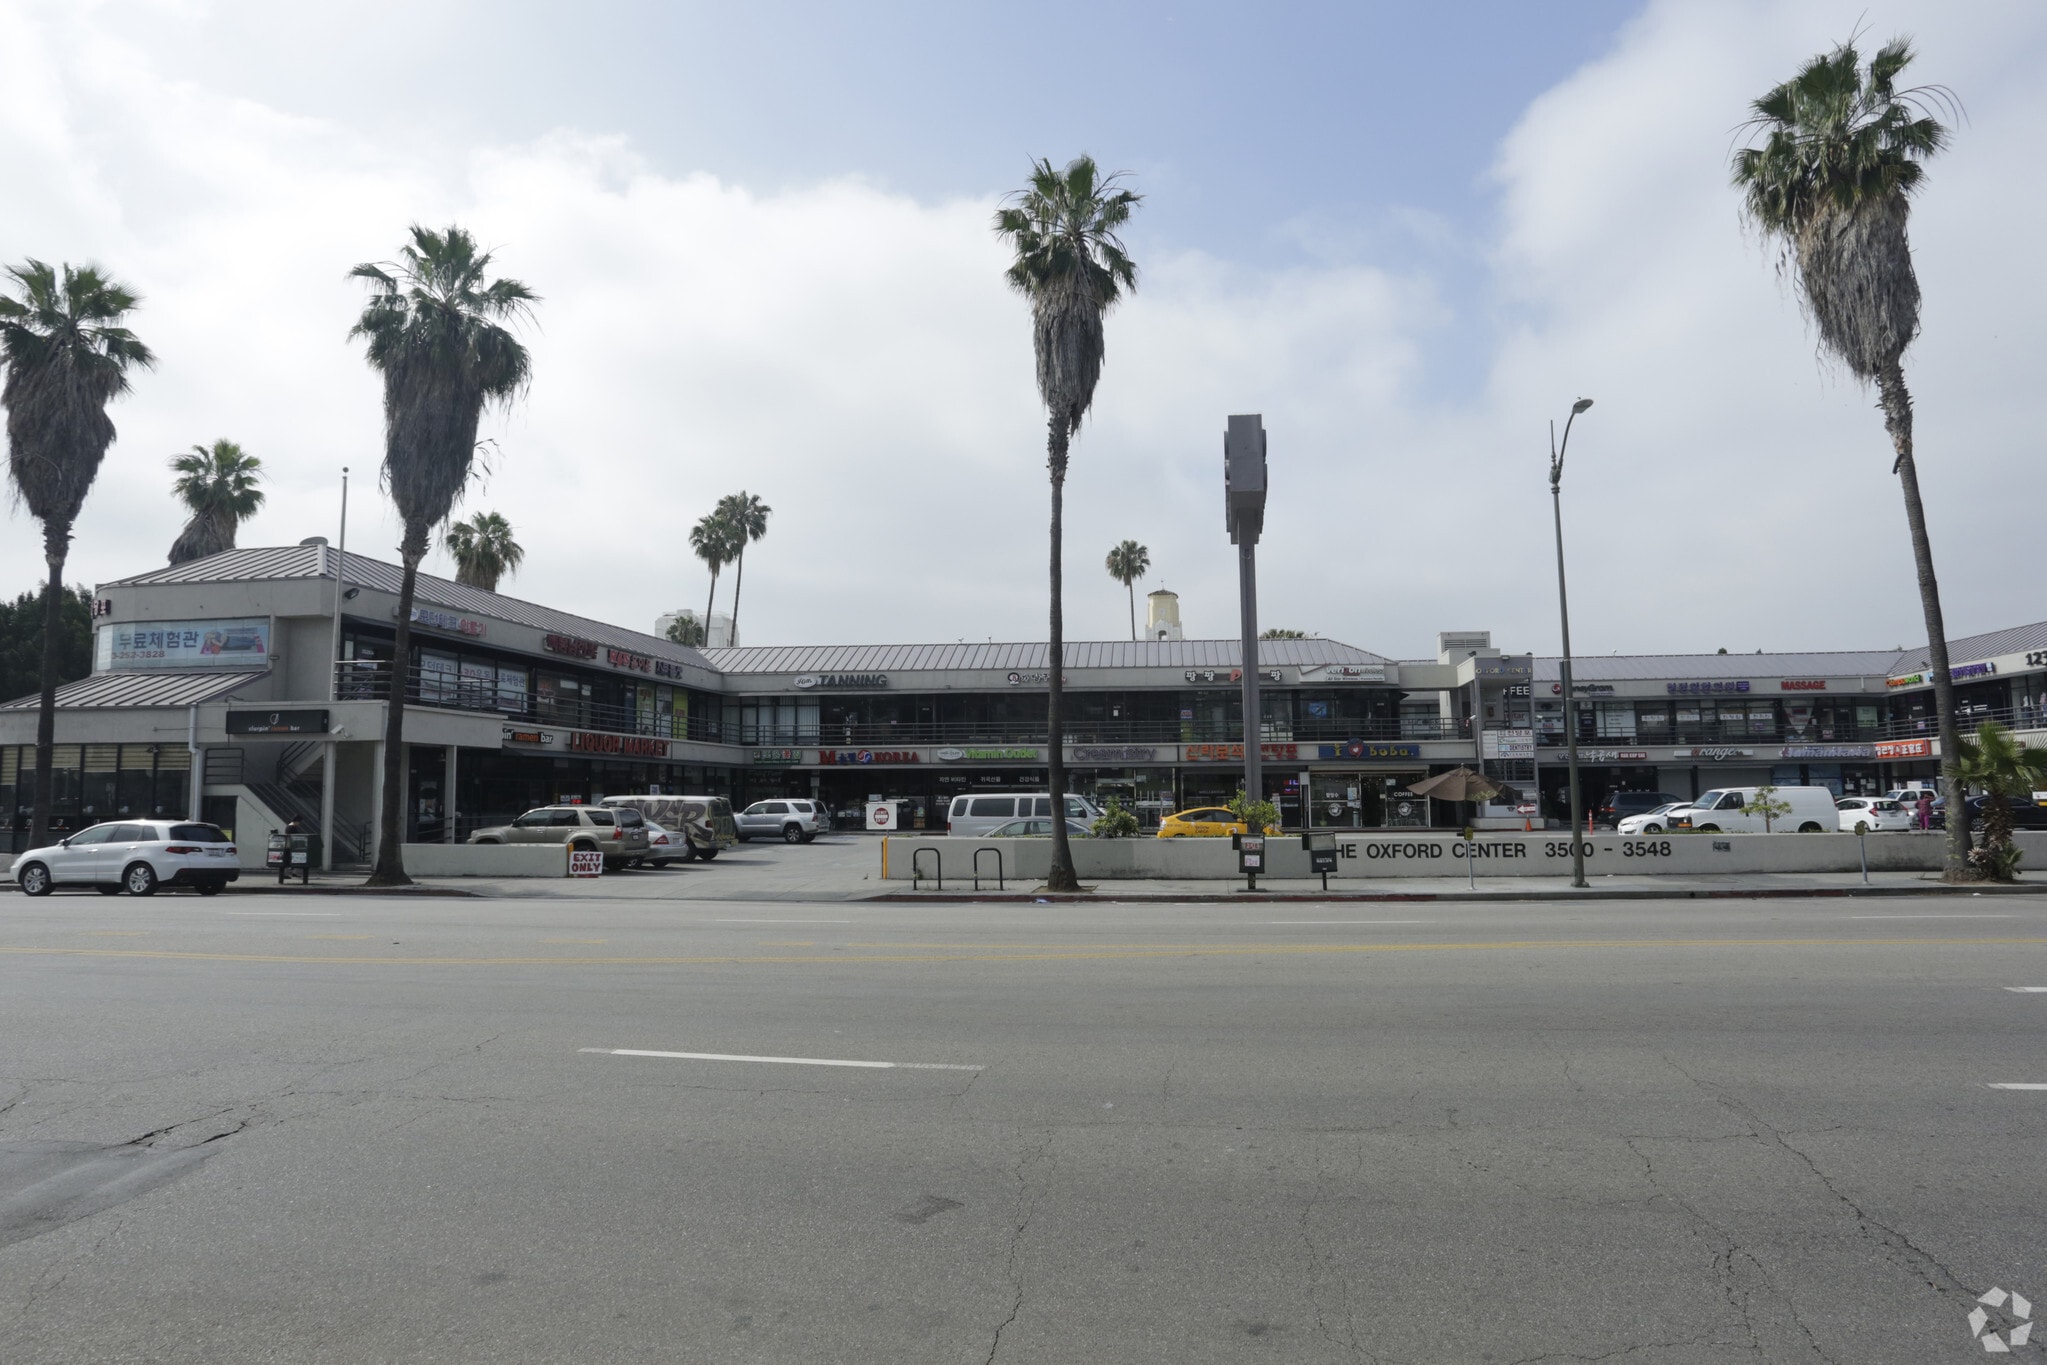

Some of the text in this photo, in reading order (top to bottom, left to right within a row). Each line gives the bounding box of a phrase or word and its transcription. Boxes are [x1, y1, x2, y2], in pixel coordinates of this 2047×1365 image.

[118, 631, 199, 649] 무료체험관
[818, 674, 888, 687] TANNING
[1781, 680, 1826, 690] MASSAGE
[1503, 686, 1530, 695] FFEE
[1572, 684, 1614, 693] neyGram
[515, 732, 540, 742] ramen
[540, 732, 552, 743] bar
[572, 732, 670, 757] LIQUOR MARKET
[874, 751, 919, 763] KOREA
[964, 747, 1002, 759] Vitamin
[1004, 747, 1039, 759] Outlet
[1335, 844, 1357, 858] HE
[1366, 843, 1442, 858] OXFORD
[1452, 842, 1526, 858] CENTER
[1622, 841, 1672, 857] 3548
[573, 853, 600, 862] EXIT
[571, 862, 600, 872] ONLY
